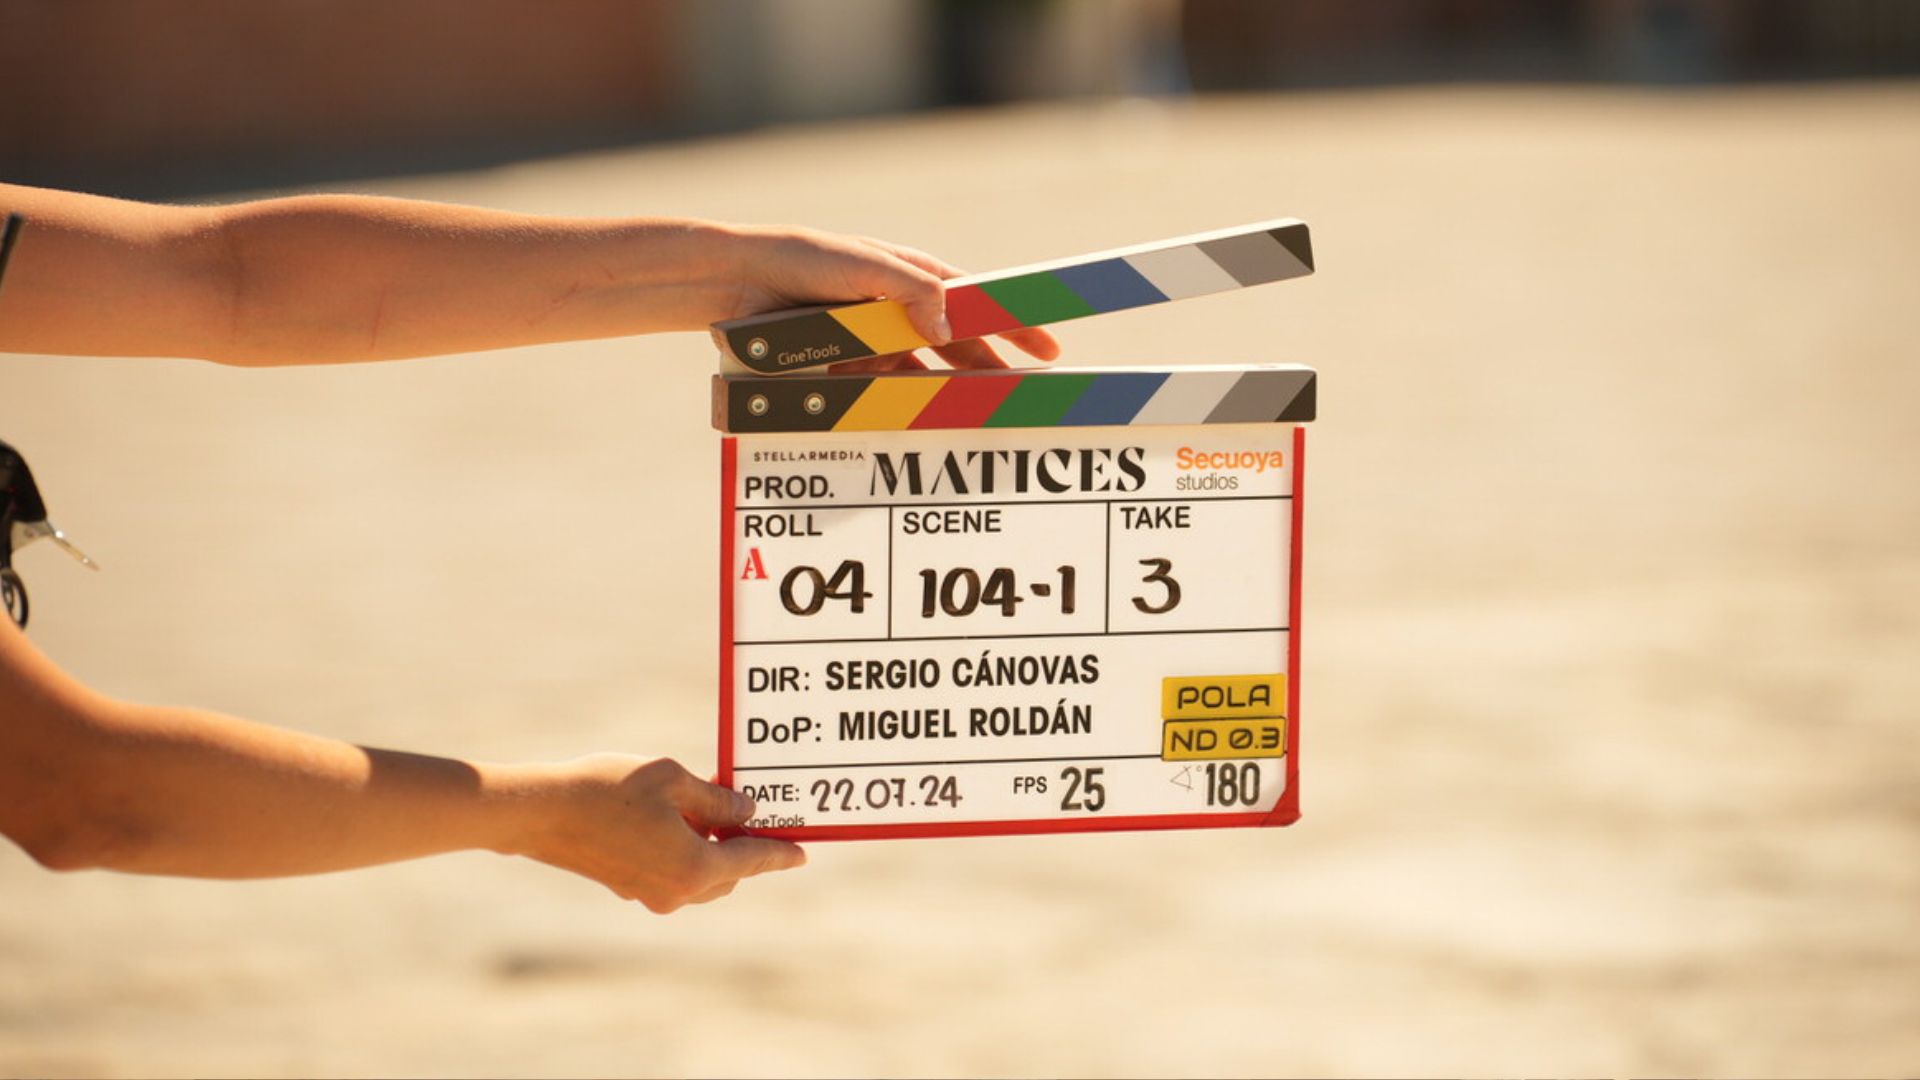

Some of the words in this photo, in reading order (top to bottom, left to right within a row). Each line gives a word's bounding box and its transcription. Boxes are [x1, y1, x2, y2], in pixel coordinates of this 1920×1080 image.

[777, 343, 841, 366] CineTools
[753, 451, 865, 462] STELLARMEDIA
[1176, 447, 1284, 473] Secuoya
[870, 447, 1147, 496] MATICES
[1176, 473, 1239, 491] studios
[745, 475, 835, 499] PROD.
[744, 514, 823, 537] ROLL
[903, 510, 1002, 534] SCENE
[1120, 506, 1191, 529] TAKE
[741, 547, 768, 580] A
[779, 560, 873, 616] 04
[919, 565, 1076, 618] 104-1
[1131, 558, 1181, 614] 3
[748, 666, 811, 692] DIR:
[825, 658, 941, 691] SERGIO
[952, 650, 1100, 687] CÁNOVAS
[1177, 684, 1271, 709] POLA
[747, 717, 822, 743] DoP:
[839, 708, 957, 741] MIGUEL
[969, 698, 1092, 737] ROLDÁN
[1171, 729, 1217, 751] ND
[810, 775, 963, 812] 22.07.24
[1013, 776, 1047, 794] FPS
[1060, 766, 1106, 811] 25
[1205, 762, 1261, 807] 180
[747, 814, 805, 828] ineTools
